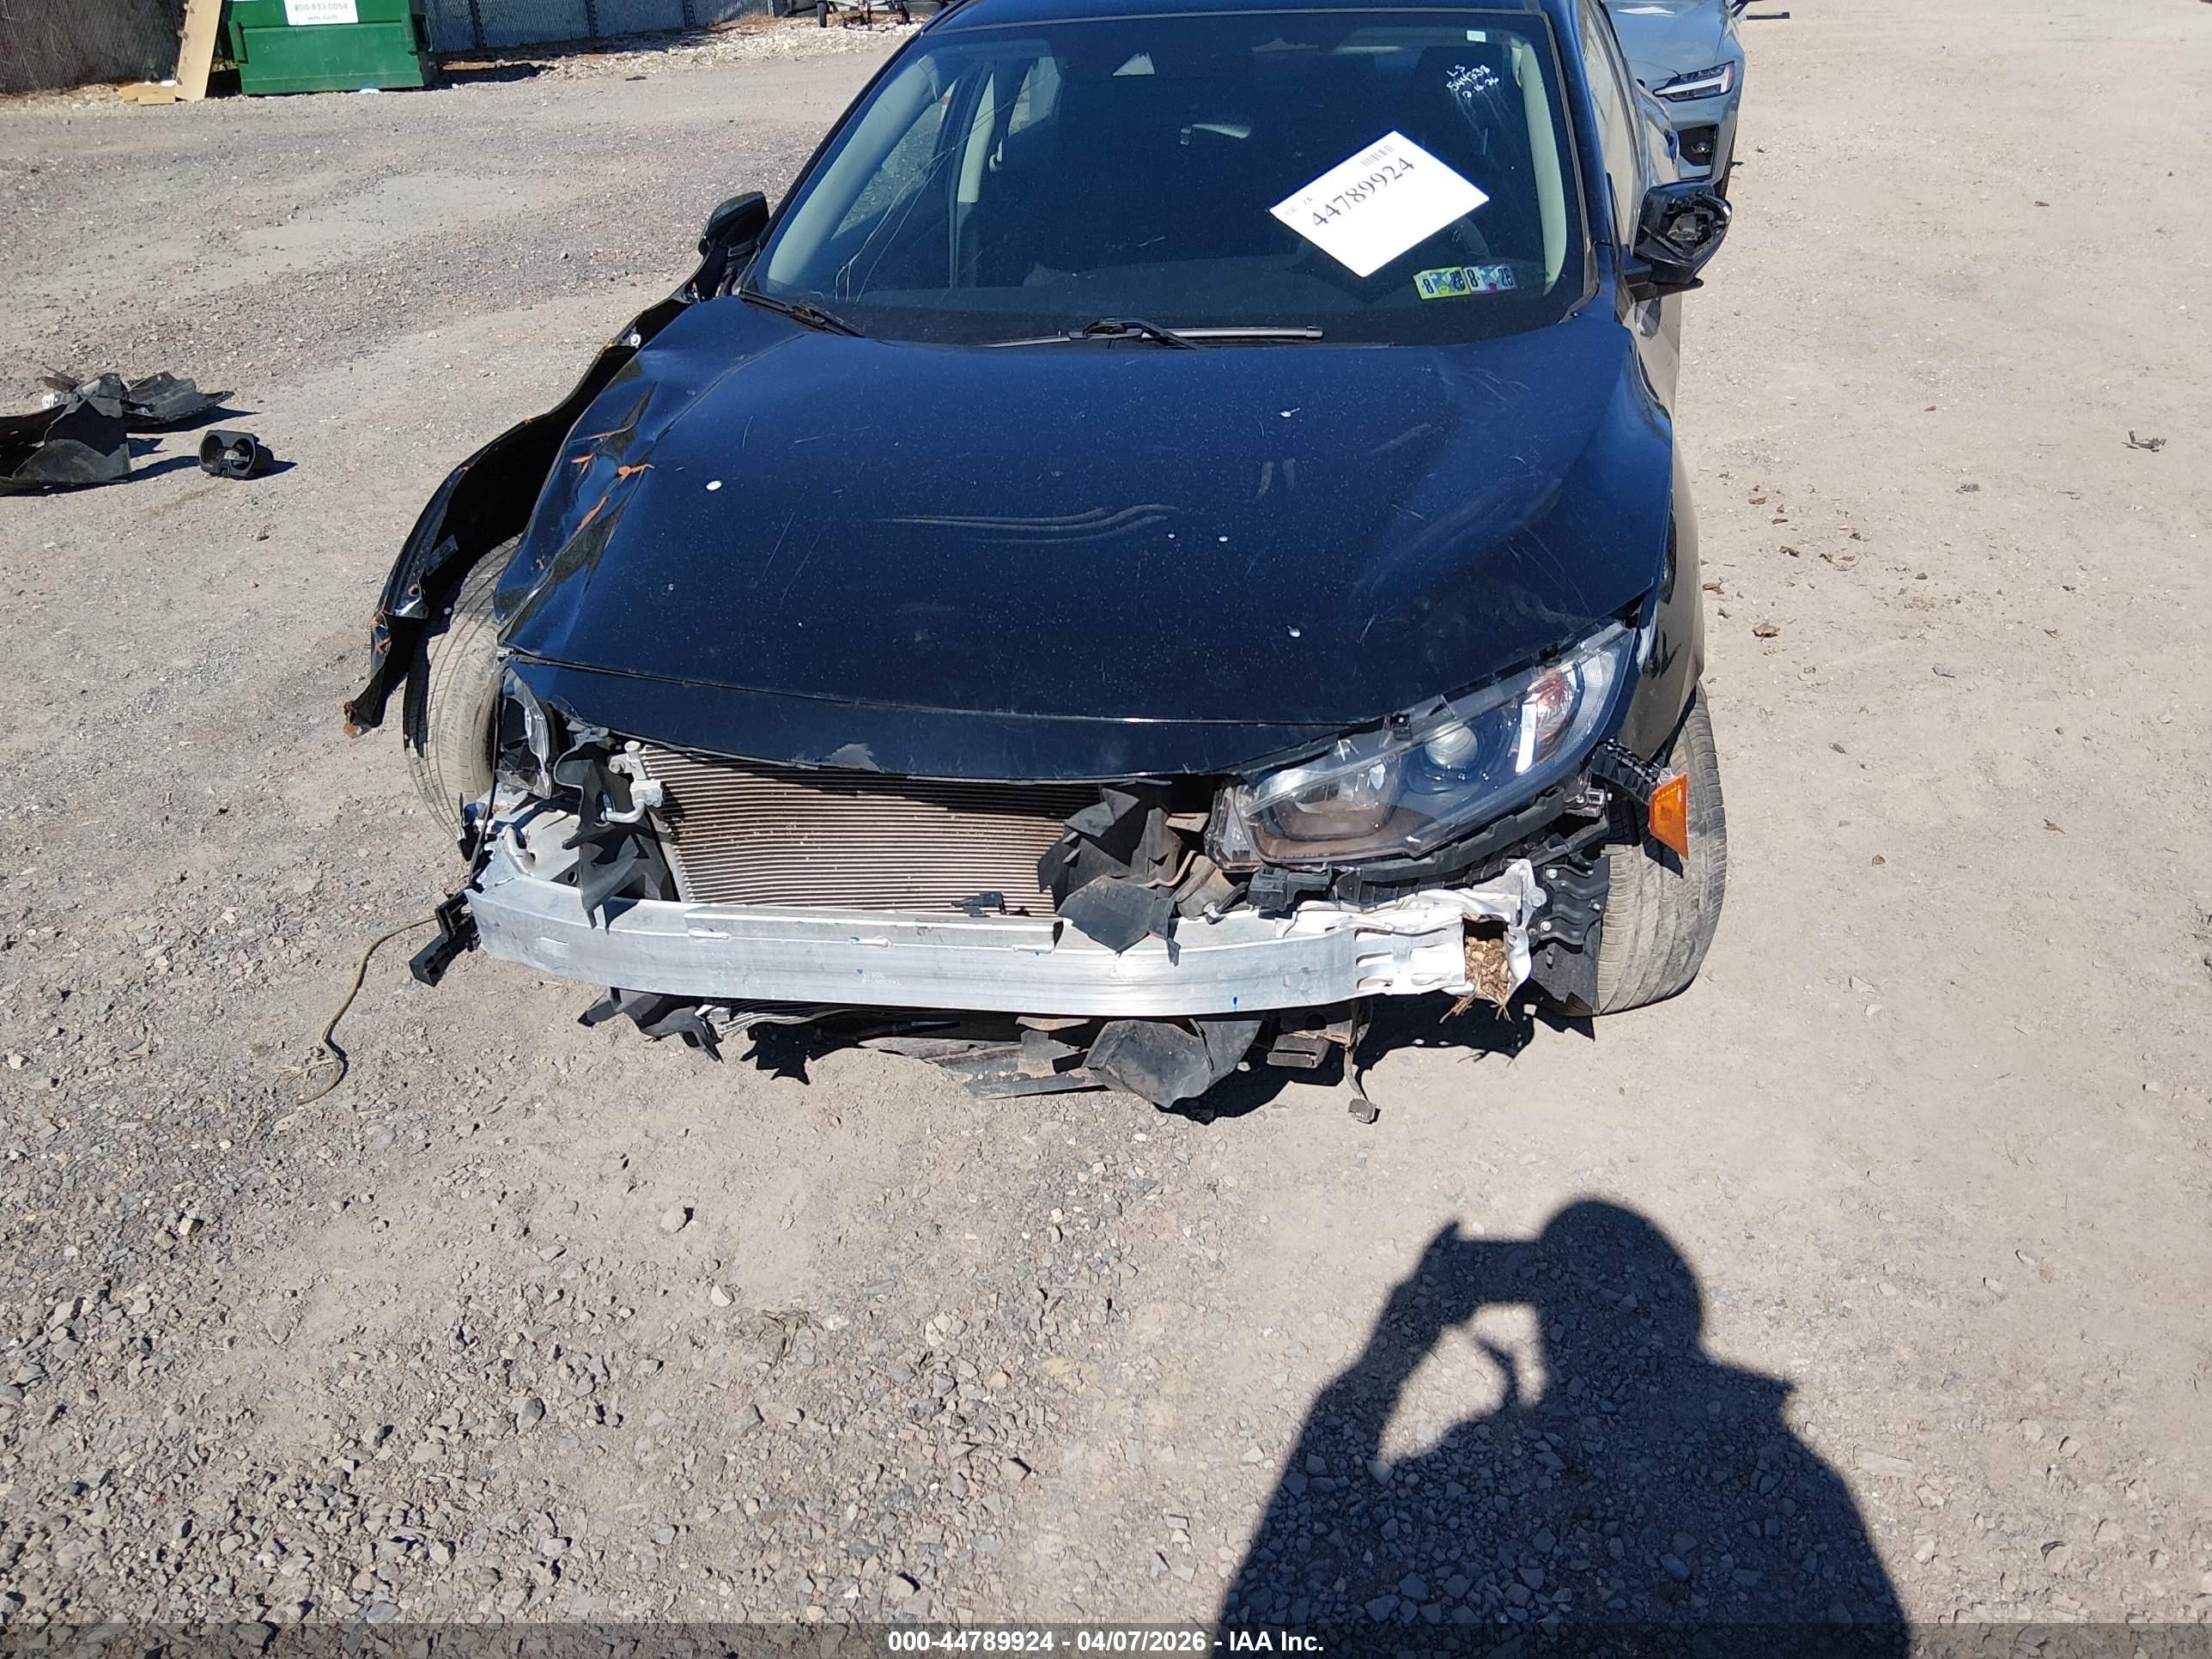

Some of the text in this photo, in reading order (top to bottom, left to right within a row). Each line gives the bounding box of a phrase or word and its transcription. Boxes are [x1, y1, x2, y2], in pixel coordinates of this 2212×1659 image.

[1312, 157, 1415, 227] 44789924
[1468, 268, 1514, 288] 8 26
